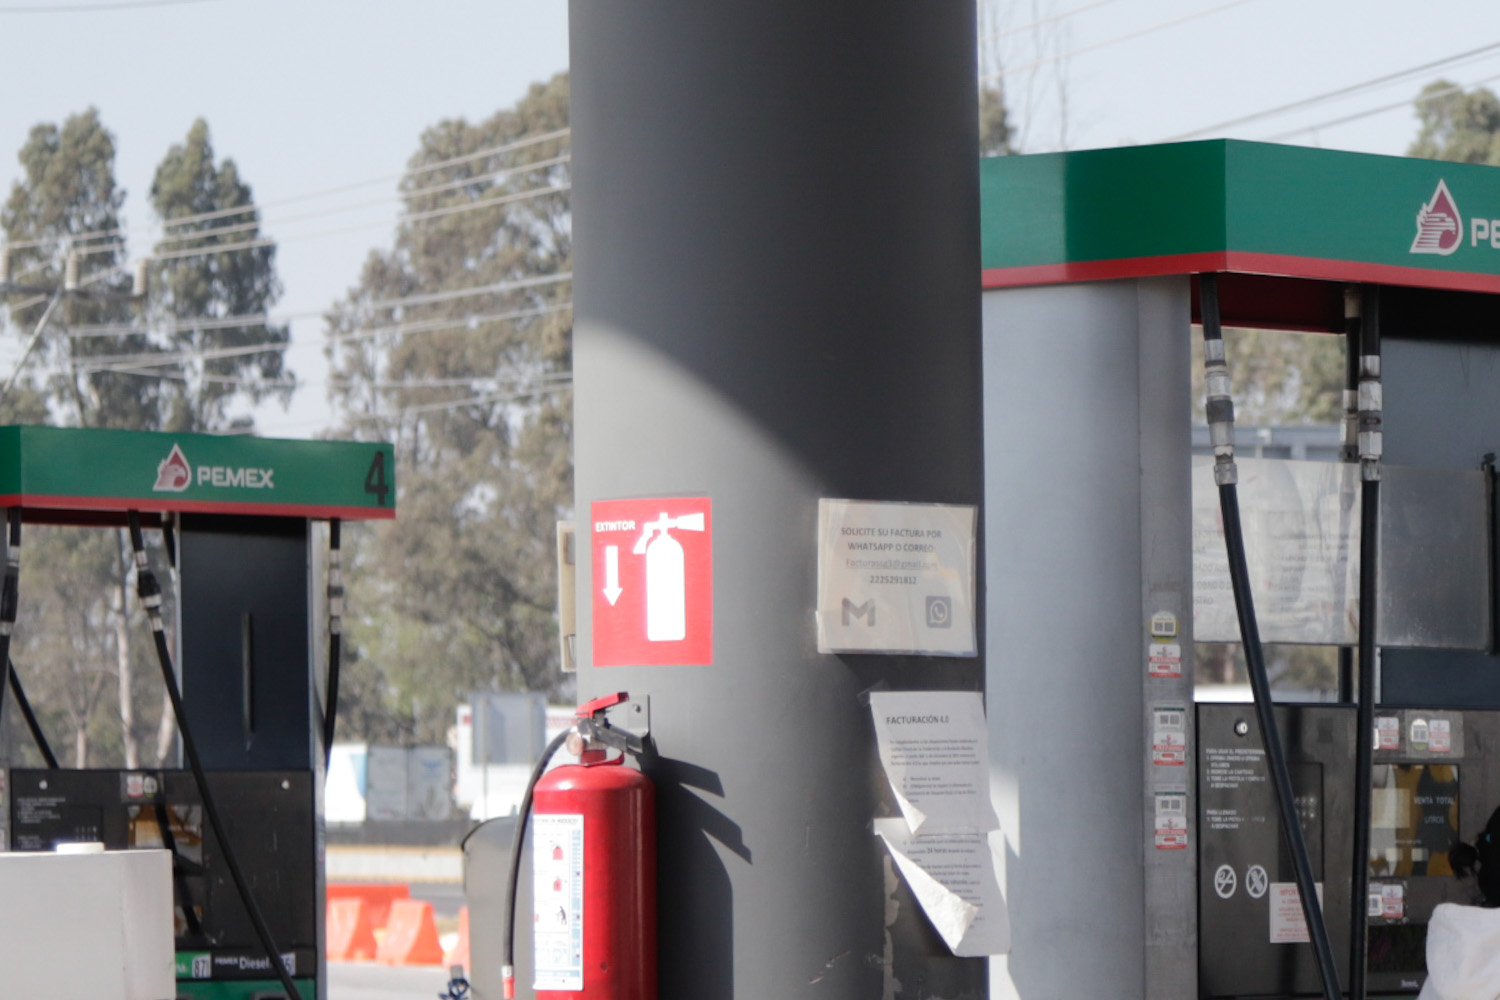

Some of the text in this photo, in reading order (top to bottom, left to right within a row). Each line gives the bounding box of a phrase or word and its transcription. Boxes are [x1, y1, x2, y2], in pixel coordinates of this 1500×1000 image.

[197, 466, 274, 488] PEMEX
[364, 451, 389, 506] 4
[595, 520, 636, 532] EXTINTOR
[841, 527, 942, 538] SOLICITE SU FACTURA POR
[848, 542, 894, 551] WHATSAPP
[895, 543, 901, 551] O
[886, 714, 939, 725] FACTURACIÓN
